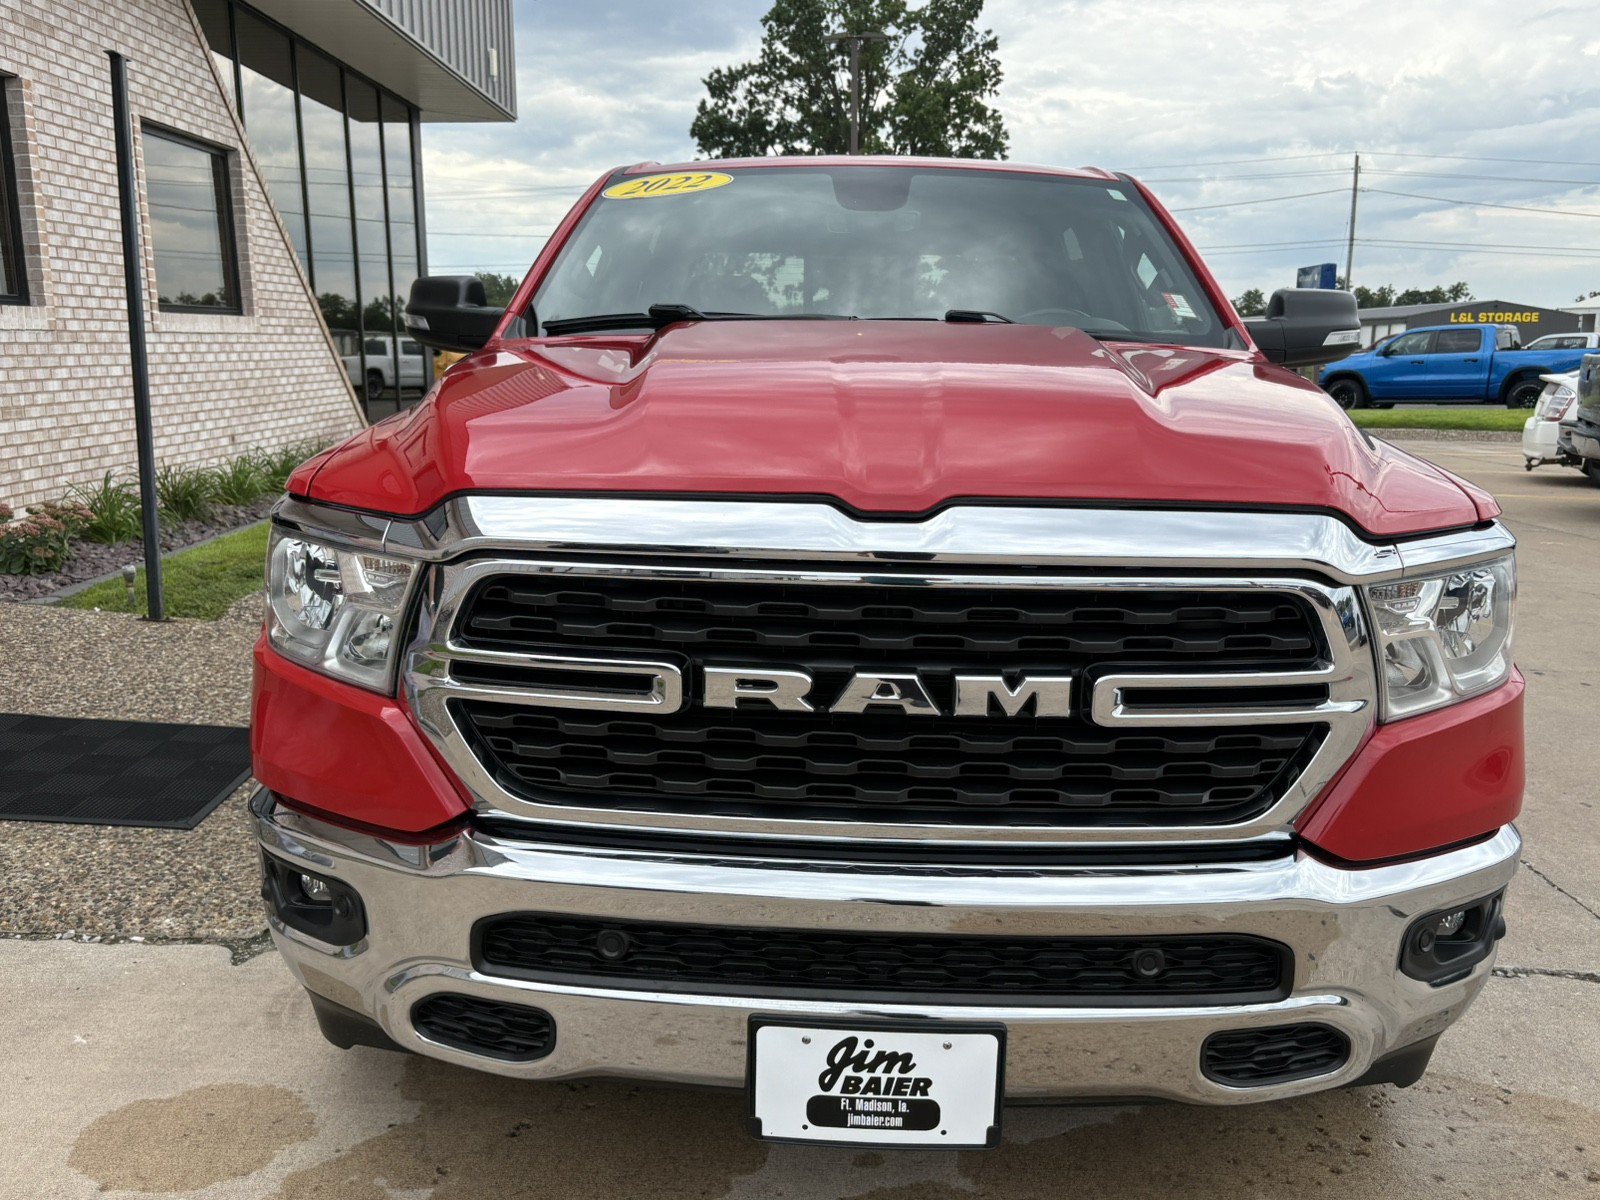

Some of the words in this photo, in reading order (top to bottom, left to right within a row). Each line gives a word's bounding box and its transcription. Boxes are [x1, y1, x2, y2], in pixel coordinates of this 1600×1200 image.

[620, 175, 713, 196] 2022
[1450, 312, 1475, 323] L&L
[1478, 312, 1540, 323] STORAGE
[702, 666, 1073, 717] RAM
[818, 1036, 917, 1092] Jim
[840, 1075, 933, 1097] BAIER
[840, 1098, 852, 1111] Ft.
[855, 1099, 895, 1114] Madison,
[847, 1113, 903, 1127] jimbaier.com
